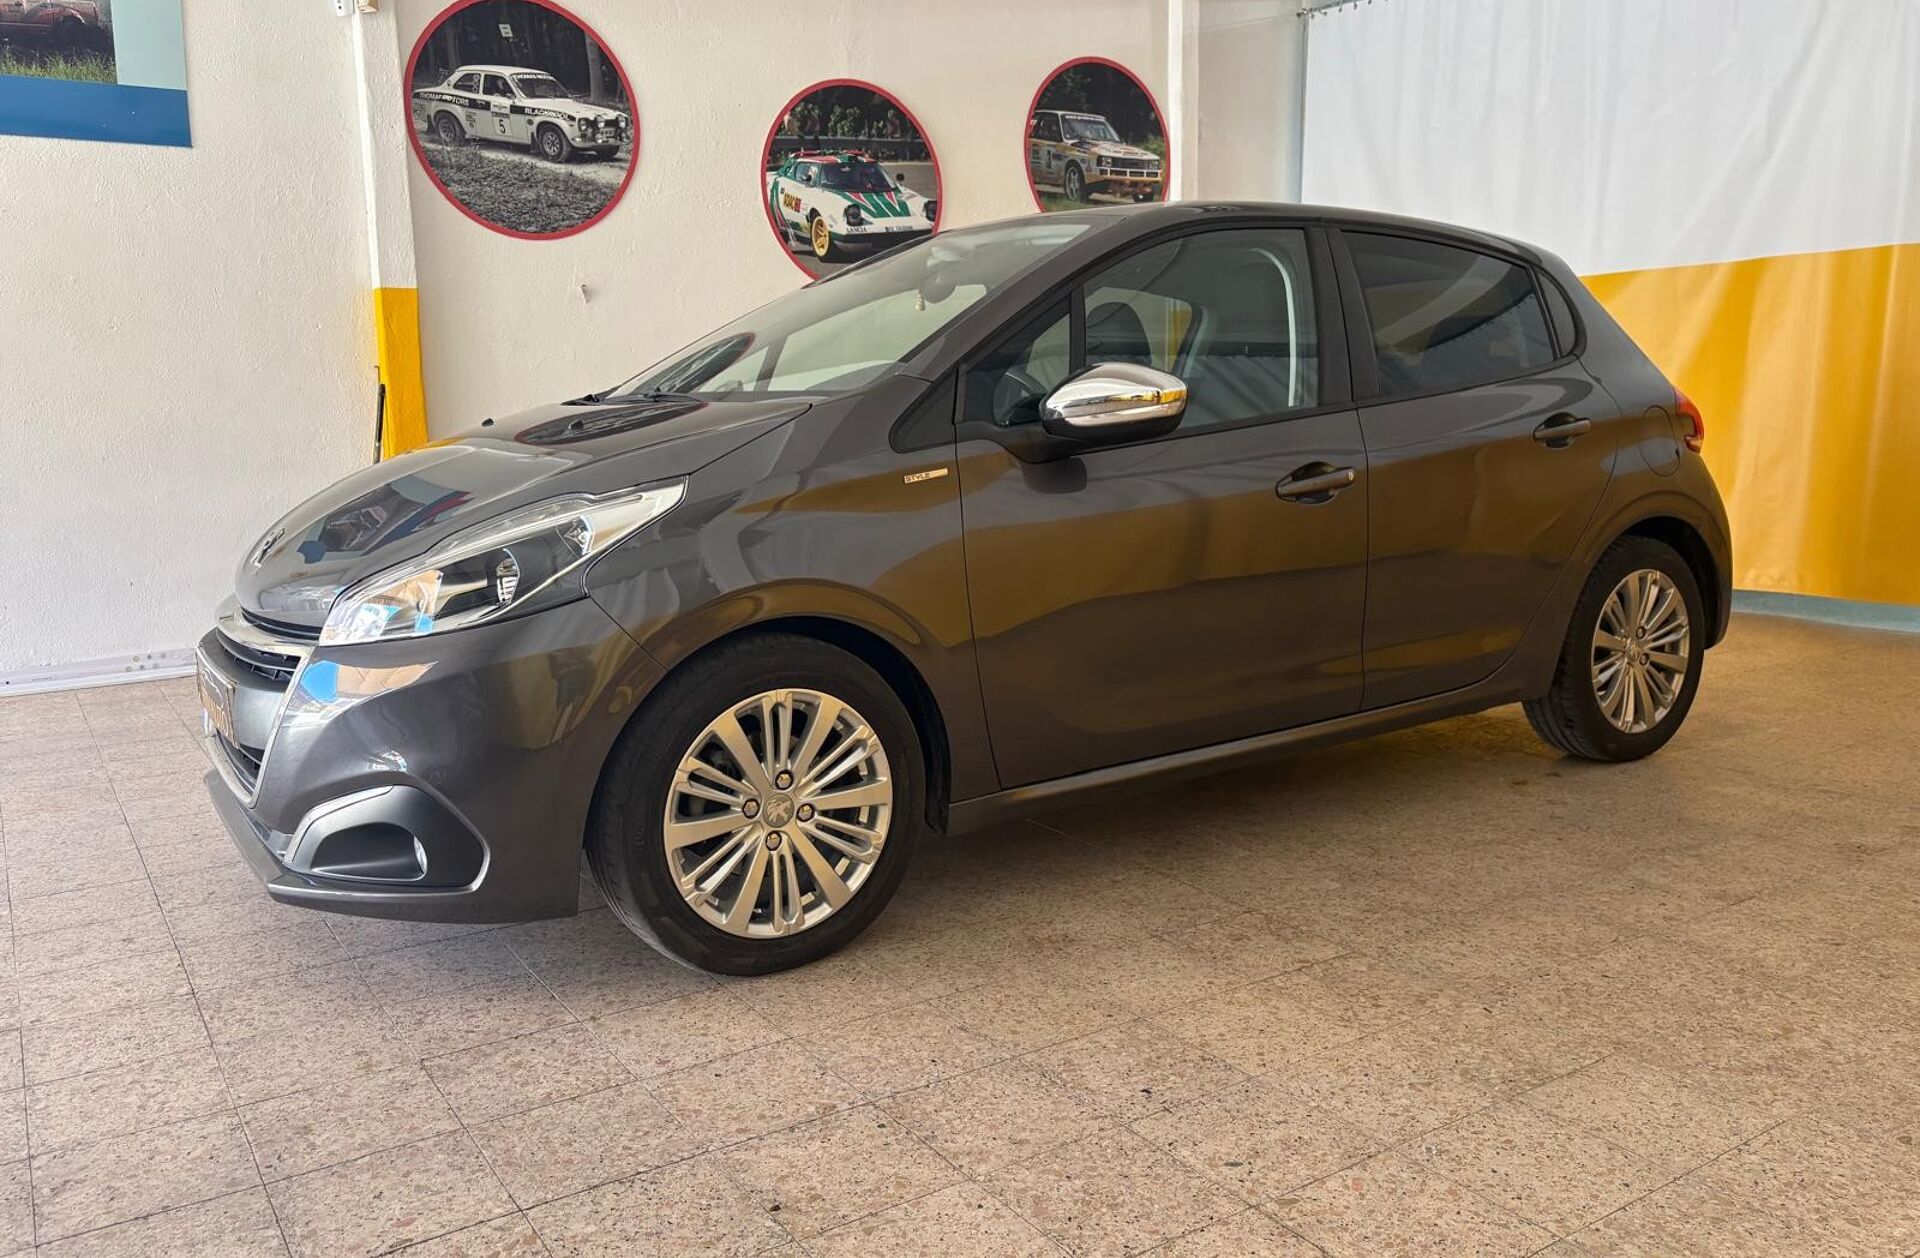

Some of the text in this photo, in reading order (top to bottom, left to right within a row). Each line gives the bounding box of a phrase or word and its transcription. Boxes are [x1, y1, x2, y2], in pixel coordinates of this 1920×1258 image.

[524, 107, 571, 121] BLACKPOOL
[498, 118, 506, 134] 5
[905, 472, 930, 482] STYLE
